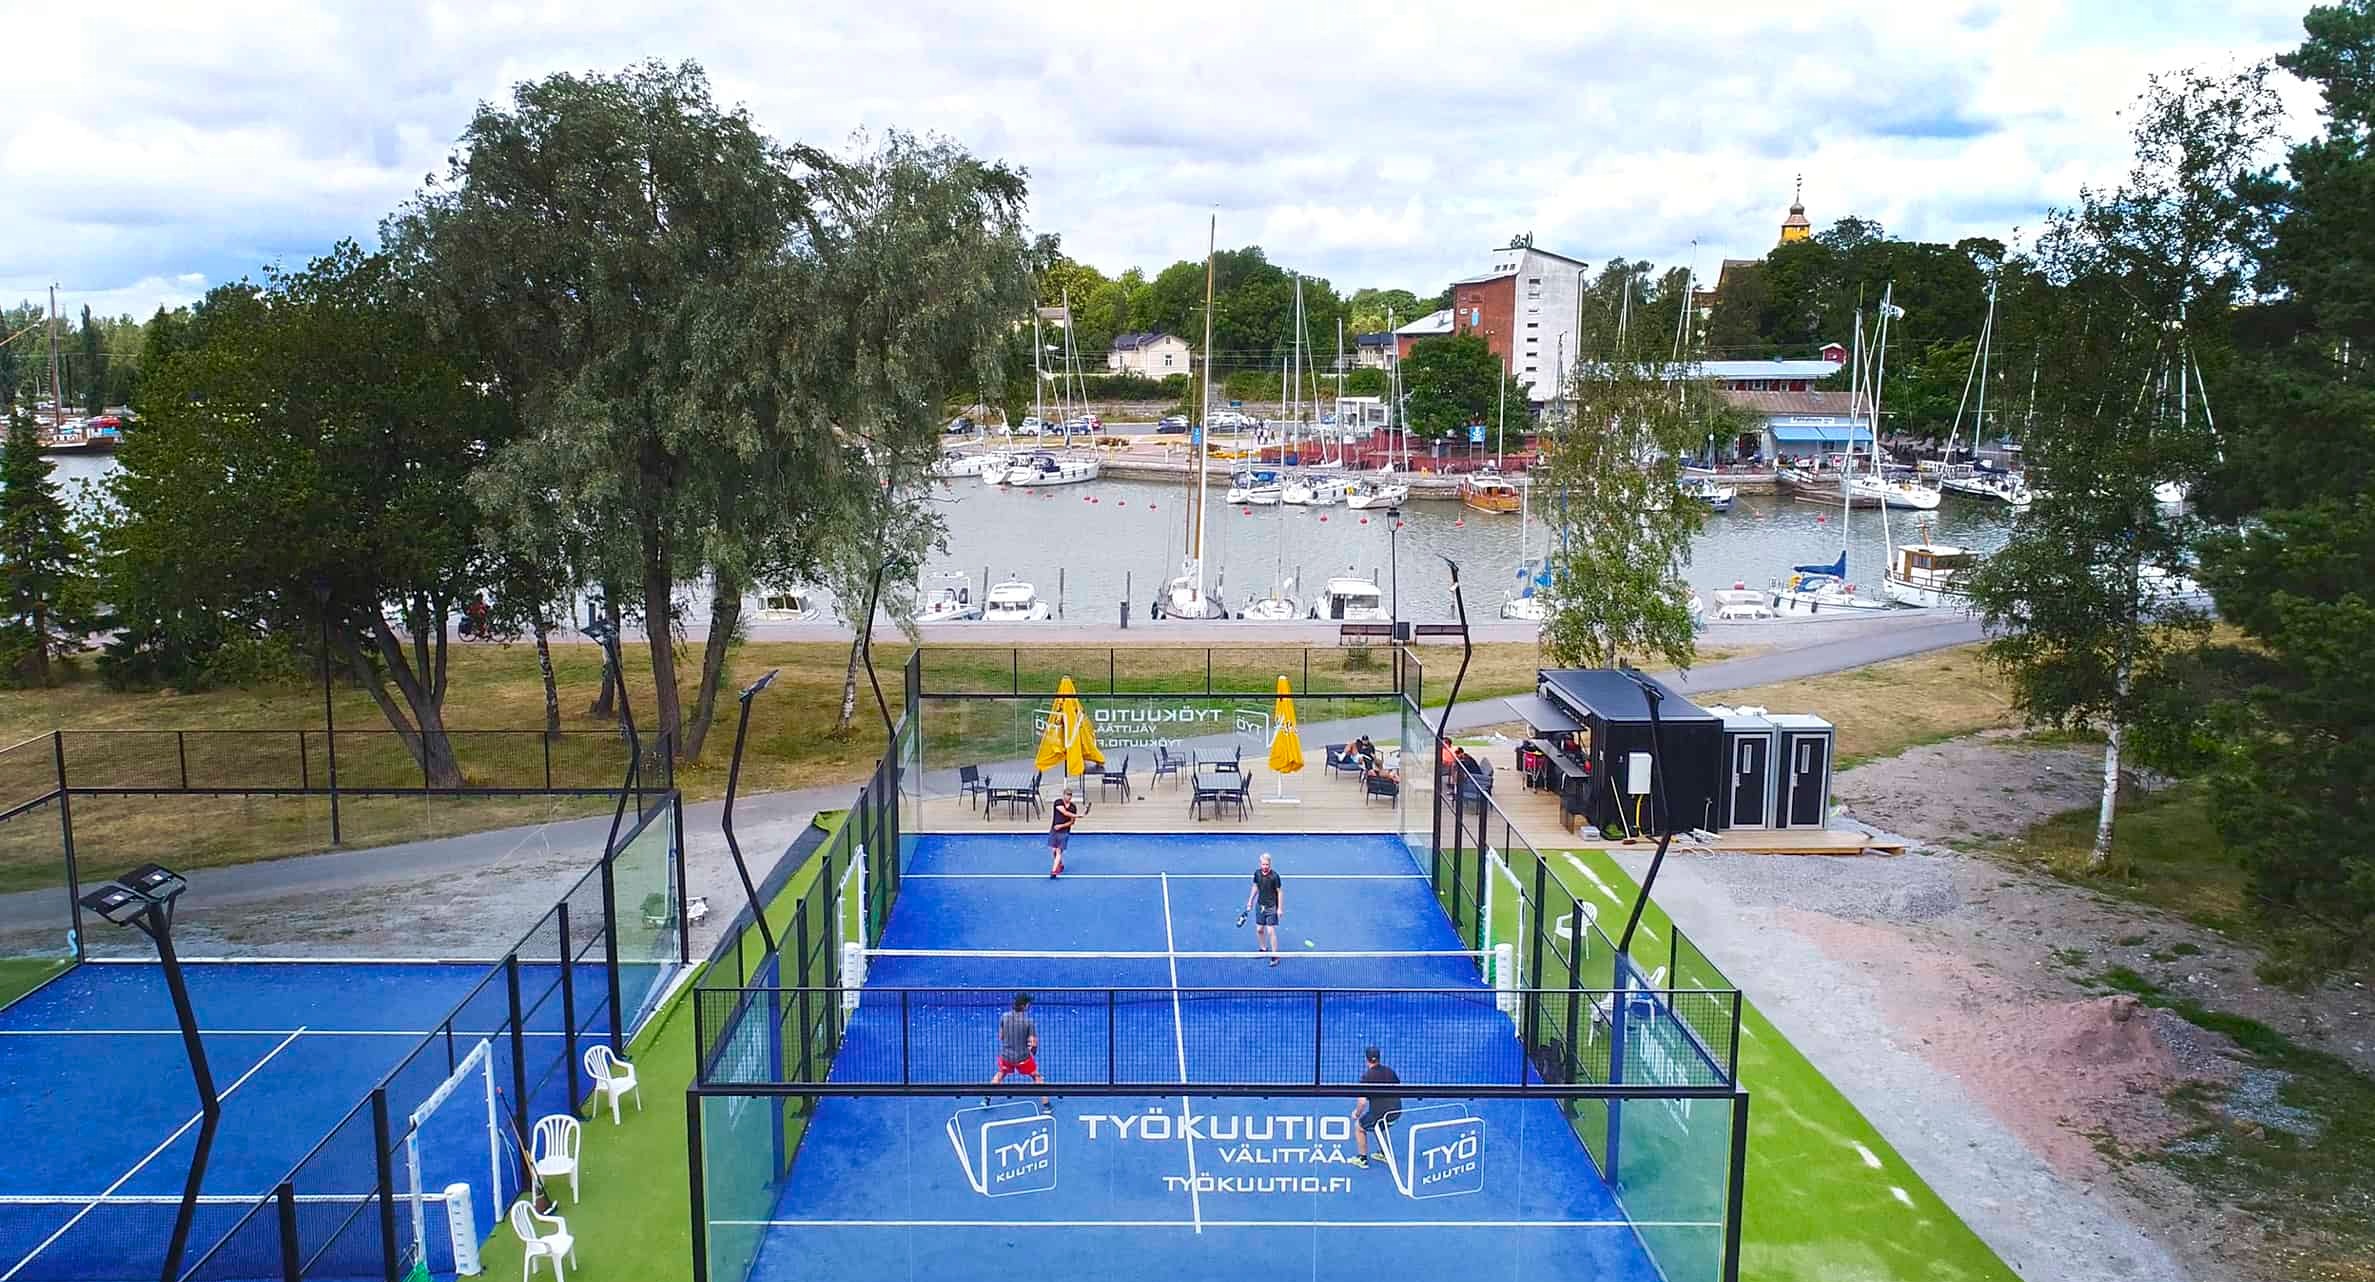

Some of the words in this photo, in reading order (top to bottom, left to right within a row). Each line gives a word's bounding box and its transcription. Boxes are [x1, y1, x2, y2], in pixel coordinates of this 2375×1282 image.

[1079, 1107, 1351, 1140] TYÖKUUTIO
[994, 1127, 1049, 1168] TYÖ
[1422, 1129, 1477, 1170] TYÖ
[996, 1159, 1049, 1184] KUUTIO
[1162, 1172, 1351, 1192] TYÖKUUTIO.FI
[1422, 1161, 1476, 1185] KUUTIO
